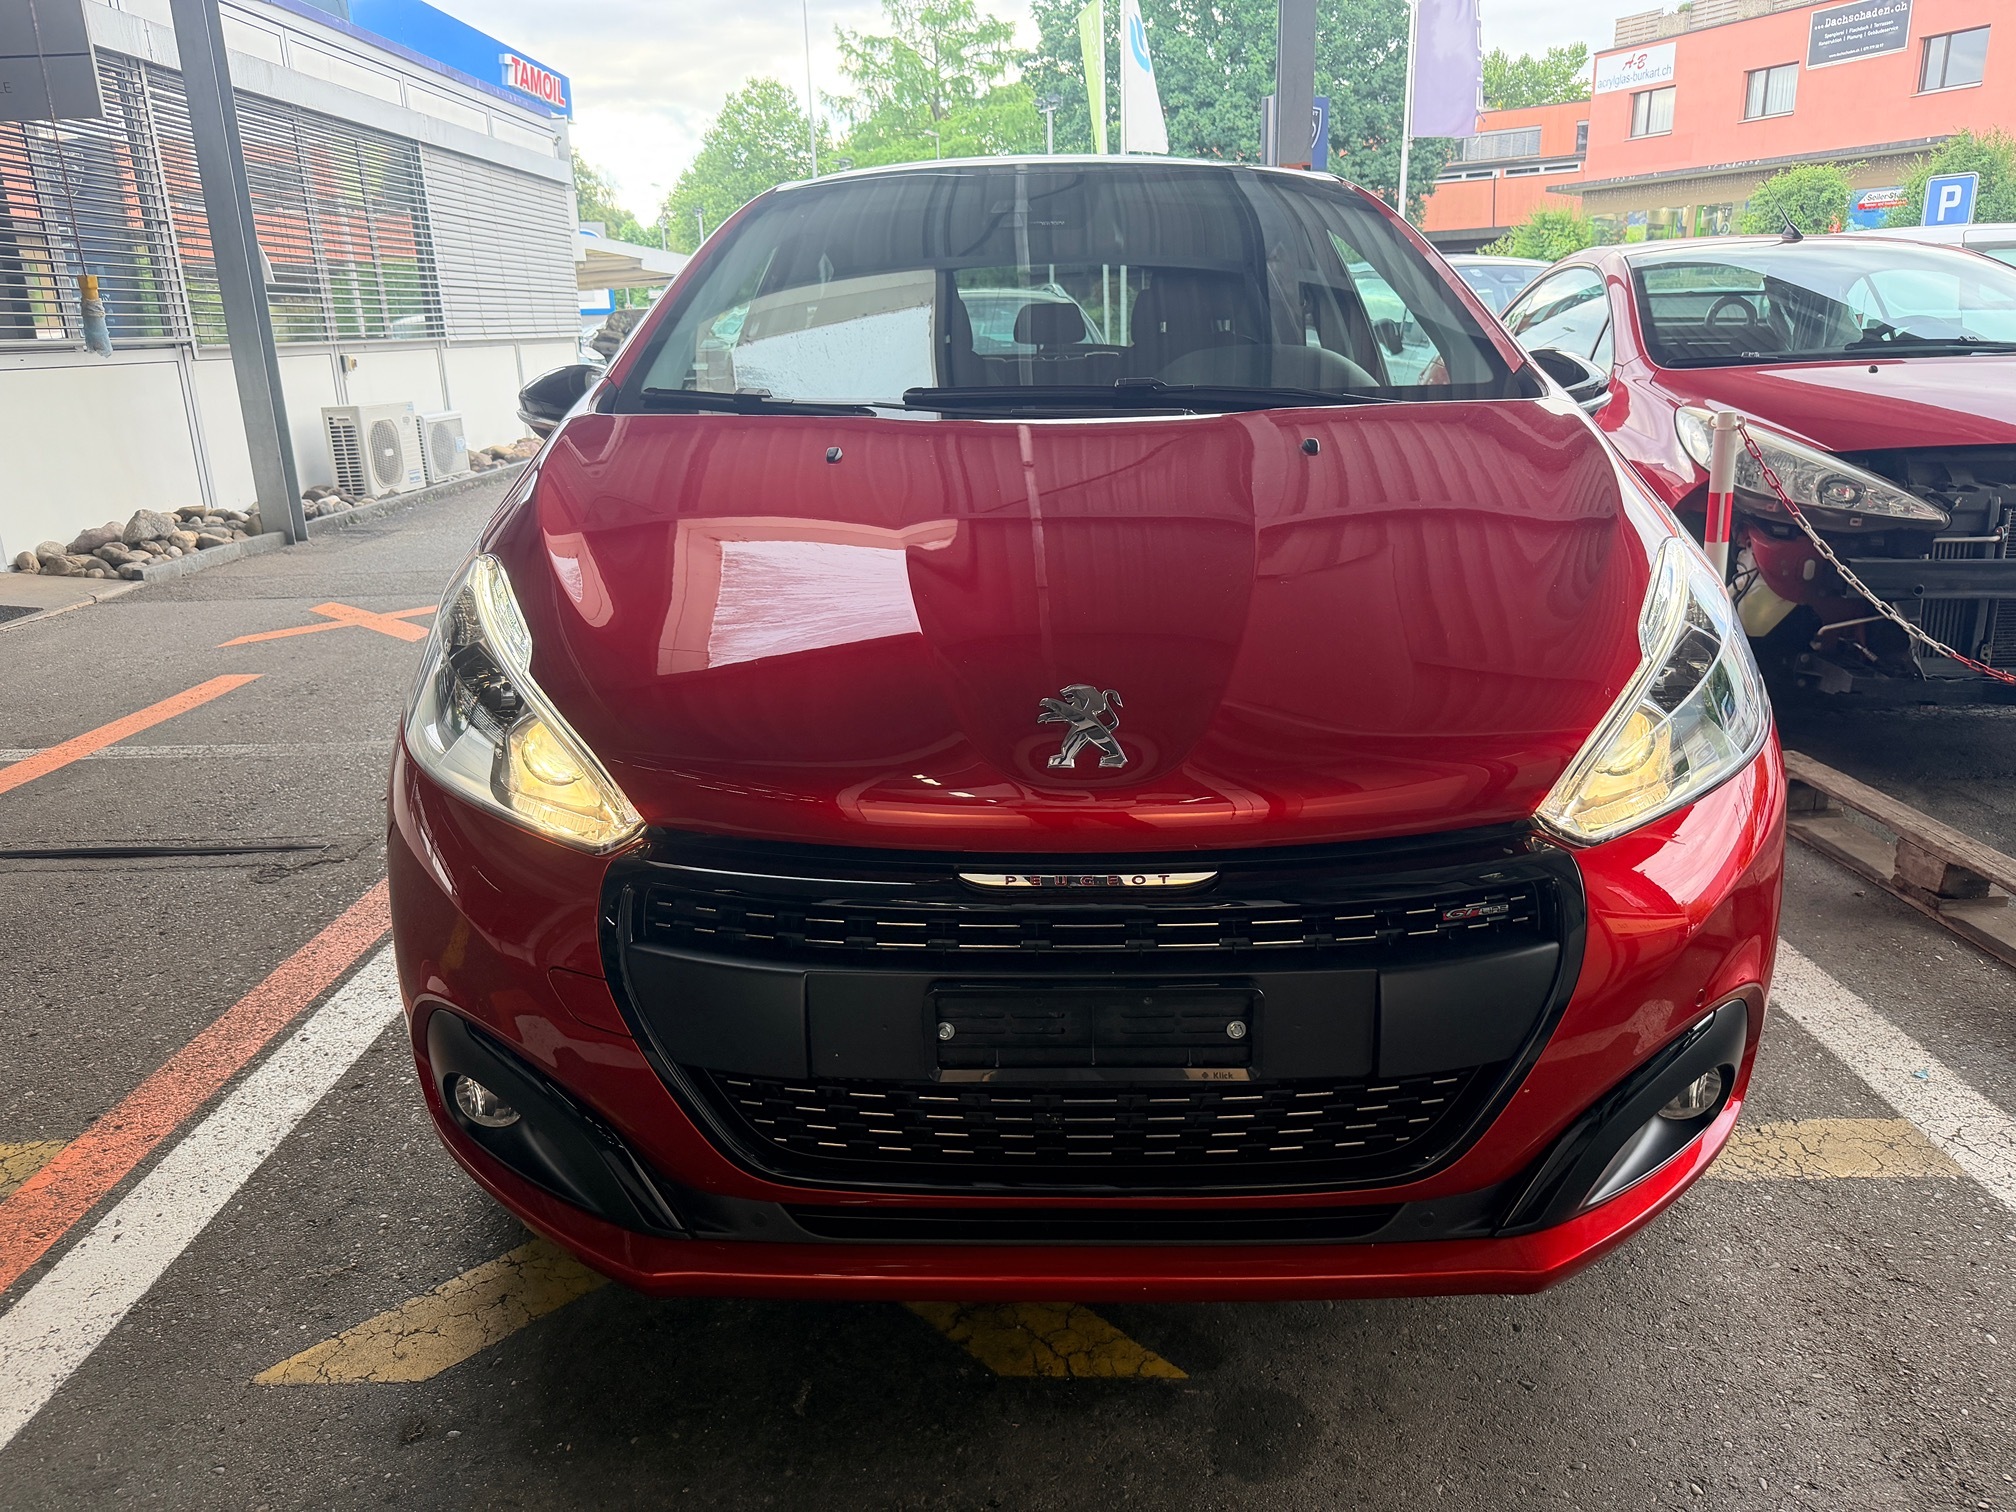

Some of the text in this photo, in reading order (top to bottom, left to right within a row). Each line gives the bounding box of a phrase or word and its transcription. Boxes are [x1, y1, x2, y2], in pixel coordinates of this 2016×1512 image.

[511, 55, 565, 106] TAMOIL
[1597, 64, 1672, 89] acrylglas-burkart.ch
[1936, 184, 1962, 222] P
[1005, 875, 1171, 886] PEUGEOT
[1446, 905, 1479, 919] GT
[1213, 1071, 1233, 1080] Klick
